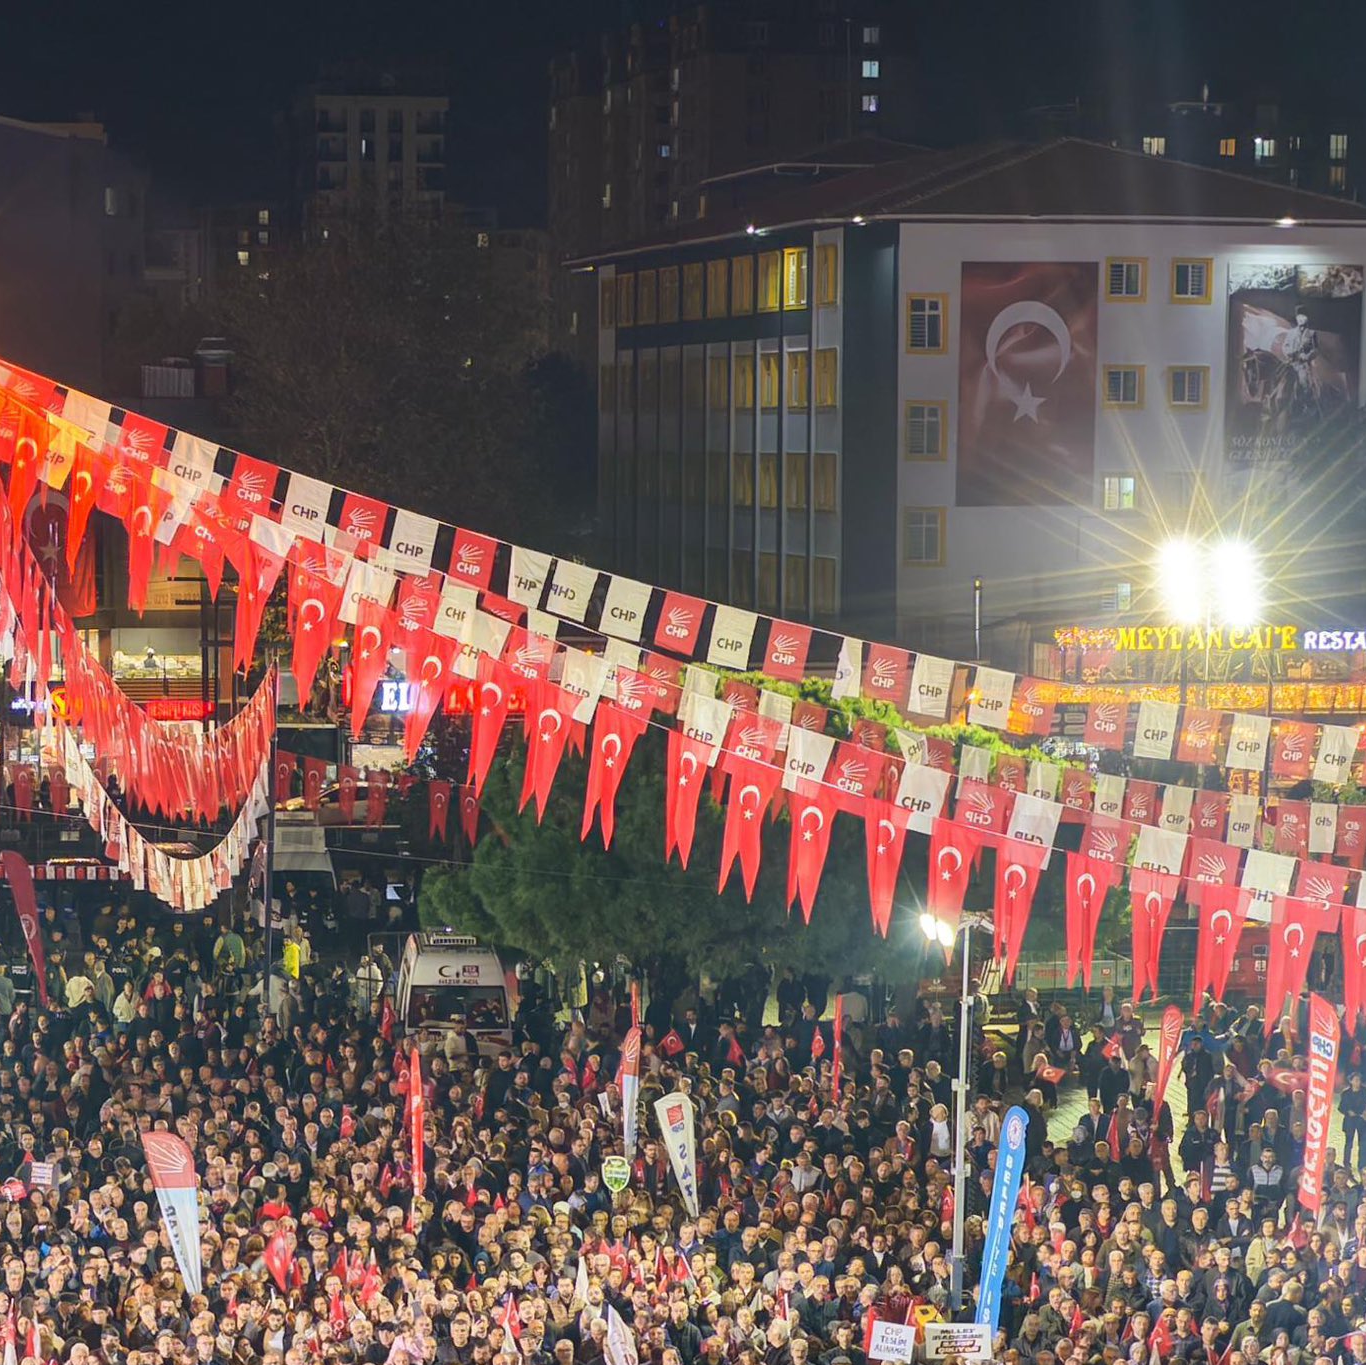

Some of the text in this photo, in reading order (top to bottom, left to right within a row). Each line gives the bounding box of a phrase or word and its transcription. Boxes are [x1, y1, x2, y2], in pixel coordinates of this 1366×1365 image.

[175, 463, 202, 481] CHP
[292, 504, 319, 521] CHP
[396, 542, 424, 559] CHP
[456, 561, 480, 575] CHP
[612, 607, 637, 621] CHP
[717, 638, 742, 652] CHP
[872, 676, 894, 688] CHP
[919, 684, 942, 697] CHP
[1144, 729, 1167, 741] CHP
[1324, 754, 1346, 766] CHP
[902, 796, 931, 812] CHP
